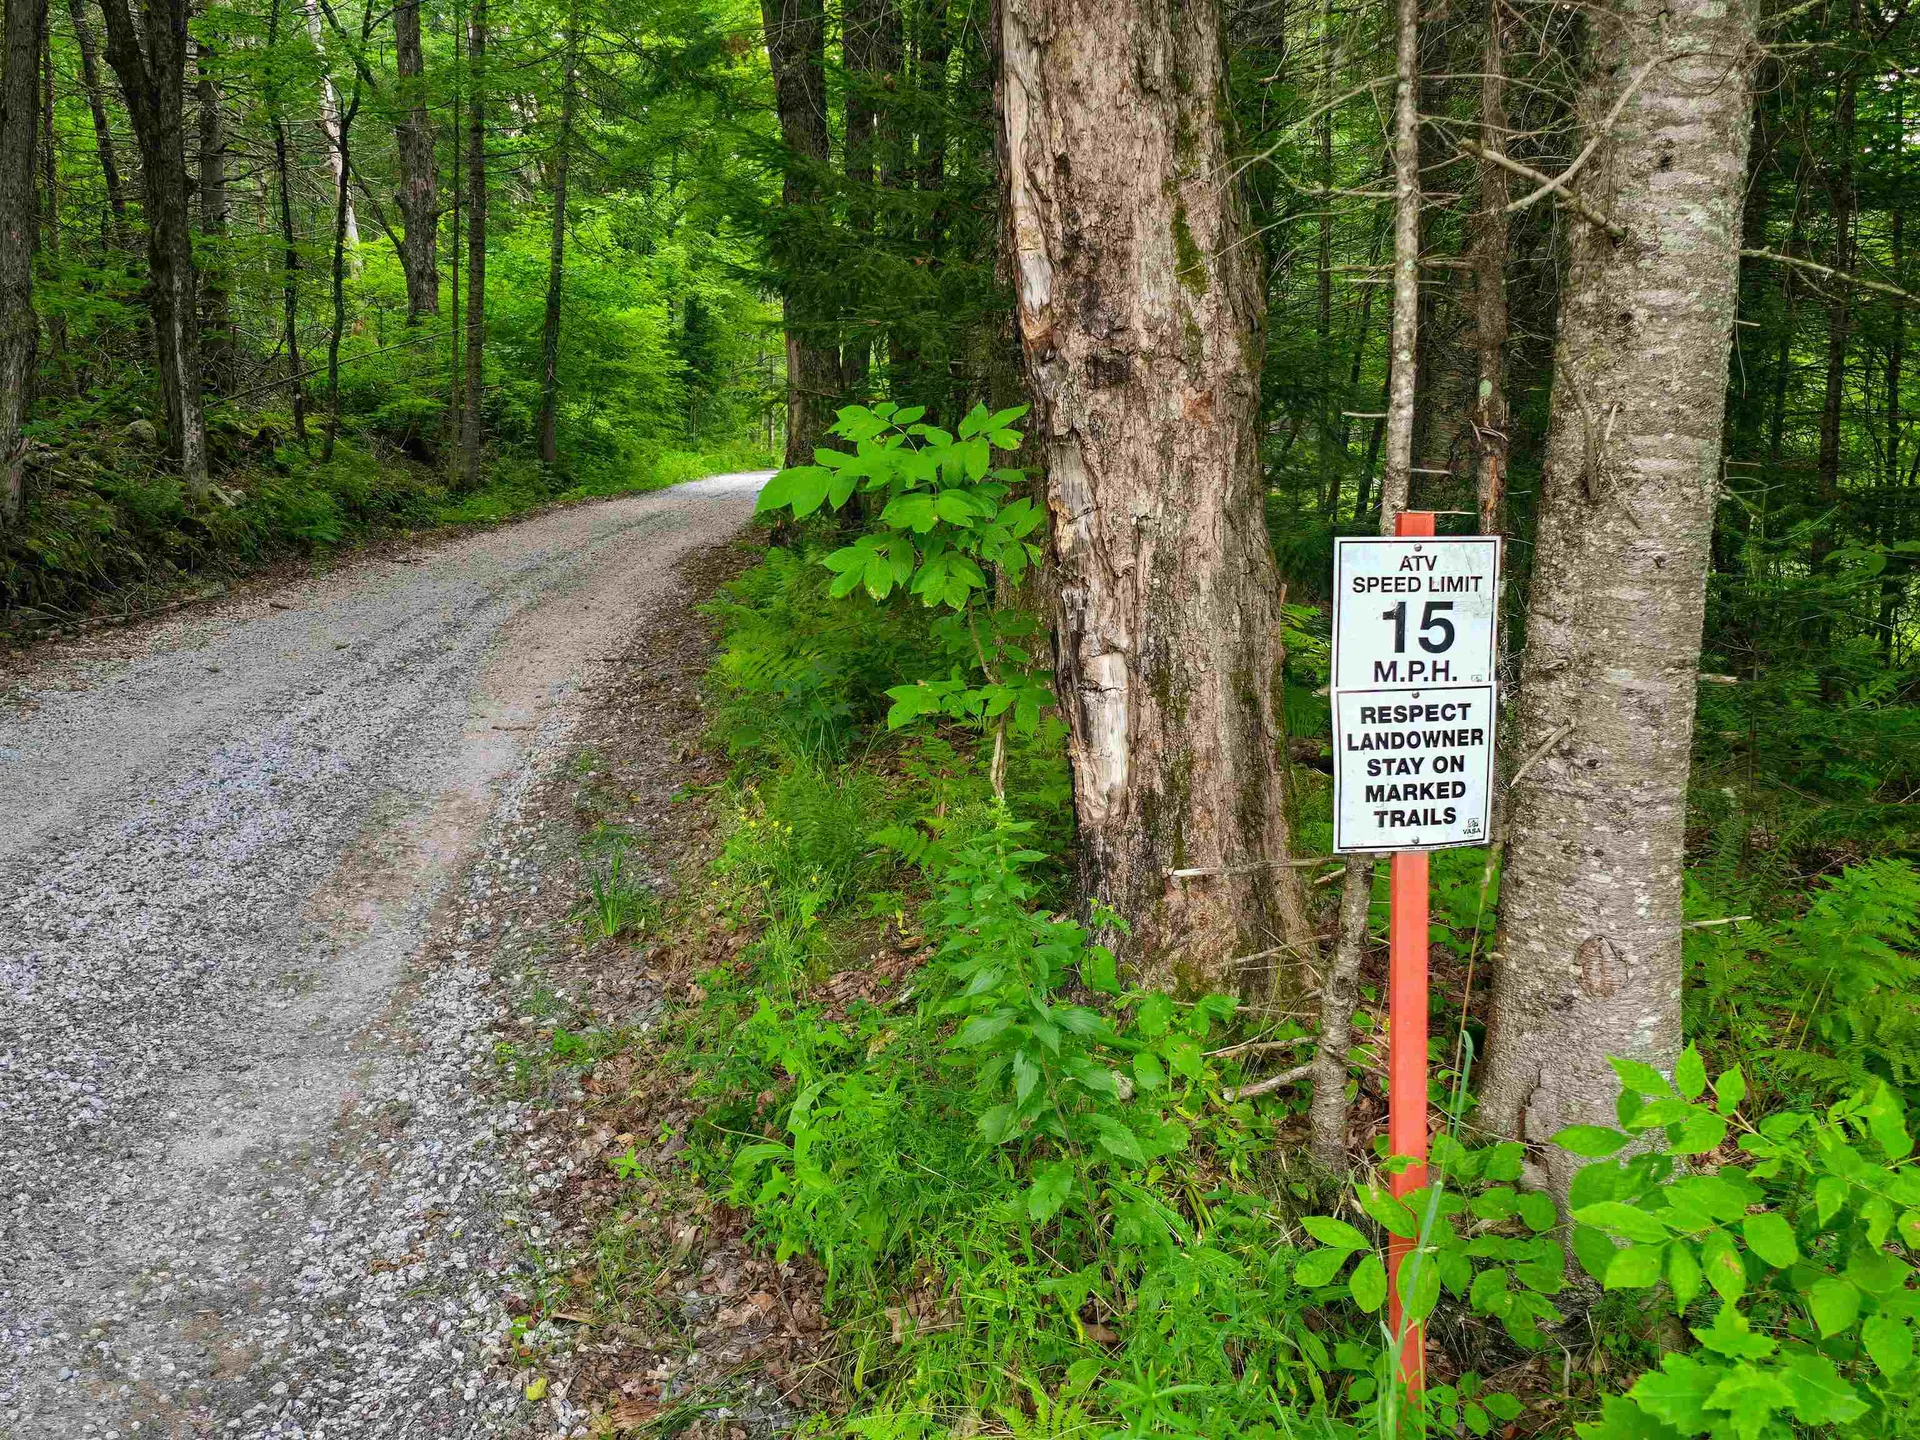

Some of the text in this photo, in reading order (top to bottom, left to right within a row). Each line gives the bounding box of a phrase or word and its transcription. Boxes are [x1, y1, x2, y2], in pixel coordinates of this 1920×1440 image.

[1399, 555, 1437, 572] ATV
[1352, 575, 1483, 594] SPEED LIMIT
[1382, 600, 1456, 654] 15
[1374, 660, 1458, 683] M.P.H.
[1360, 702, 1472, 725] RESPECT
[1347, 728, 1484, 751] LANDOWNER
[1366, 755, 1465, 777] STAY ON
[1365, 781, 1466, 803] MARKED
[1373, 806, 1457, 828] TRAILS
